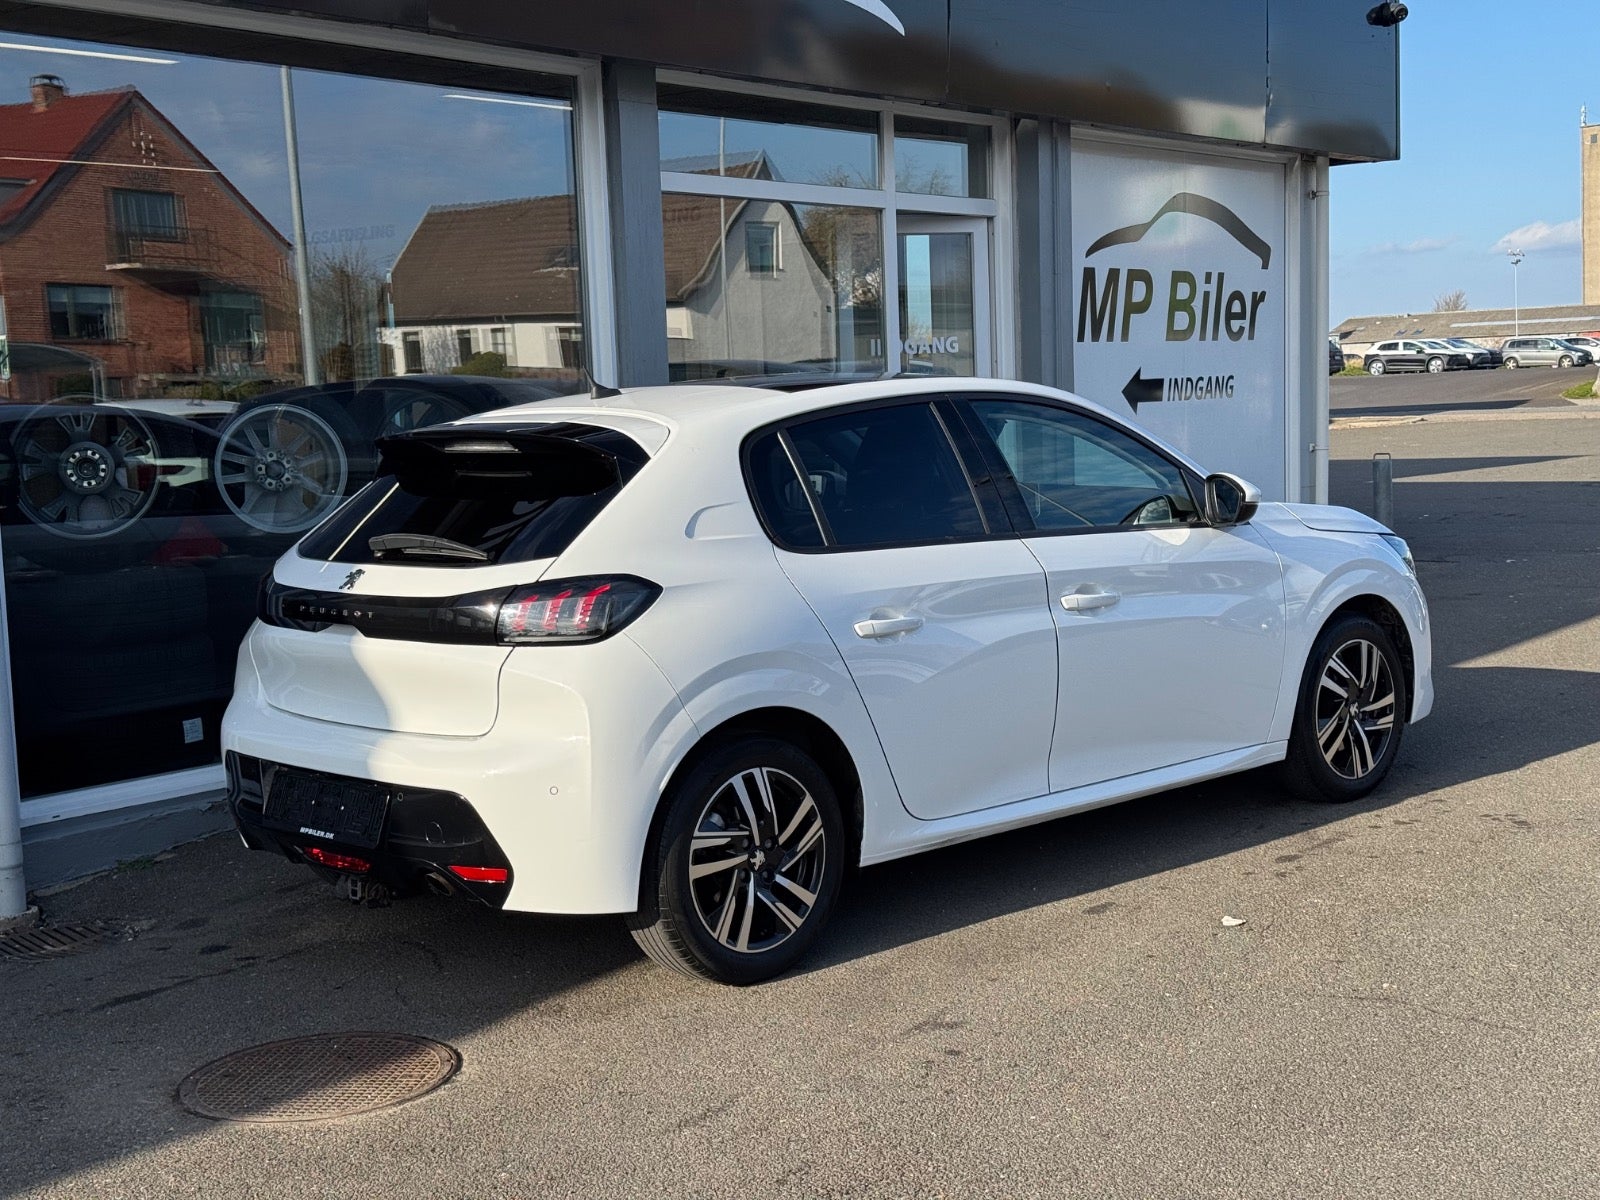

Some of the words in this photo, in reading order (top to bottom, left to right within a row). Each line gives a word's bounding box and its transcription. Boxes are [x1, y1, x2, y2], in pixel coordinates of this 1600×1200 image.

[287, 224, 396, 244] SGSAFDELING
[1077, 266, 1154, 342] MP
[1165, 270, 1267, 342] Biler
[1167, 374, 1235, 402] INDGANG
[300, 604, 375, 619] PEUGEOT
[299, 826, 335, 840] MPBILER.DK
